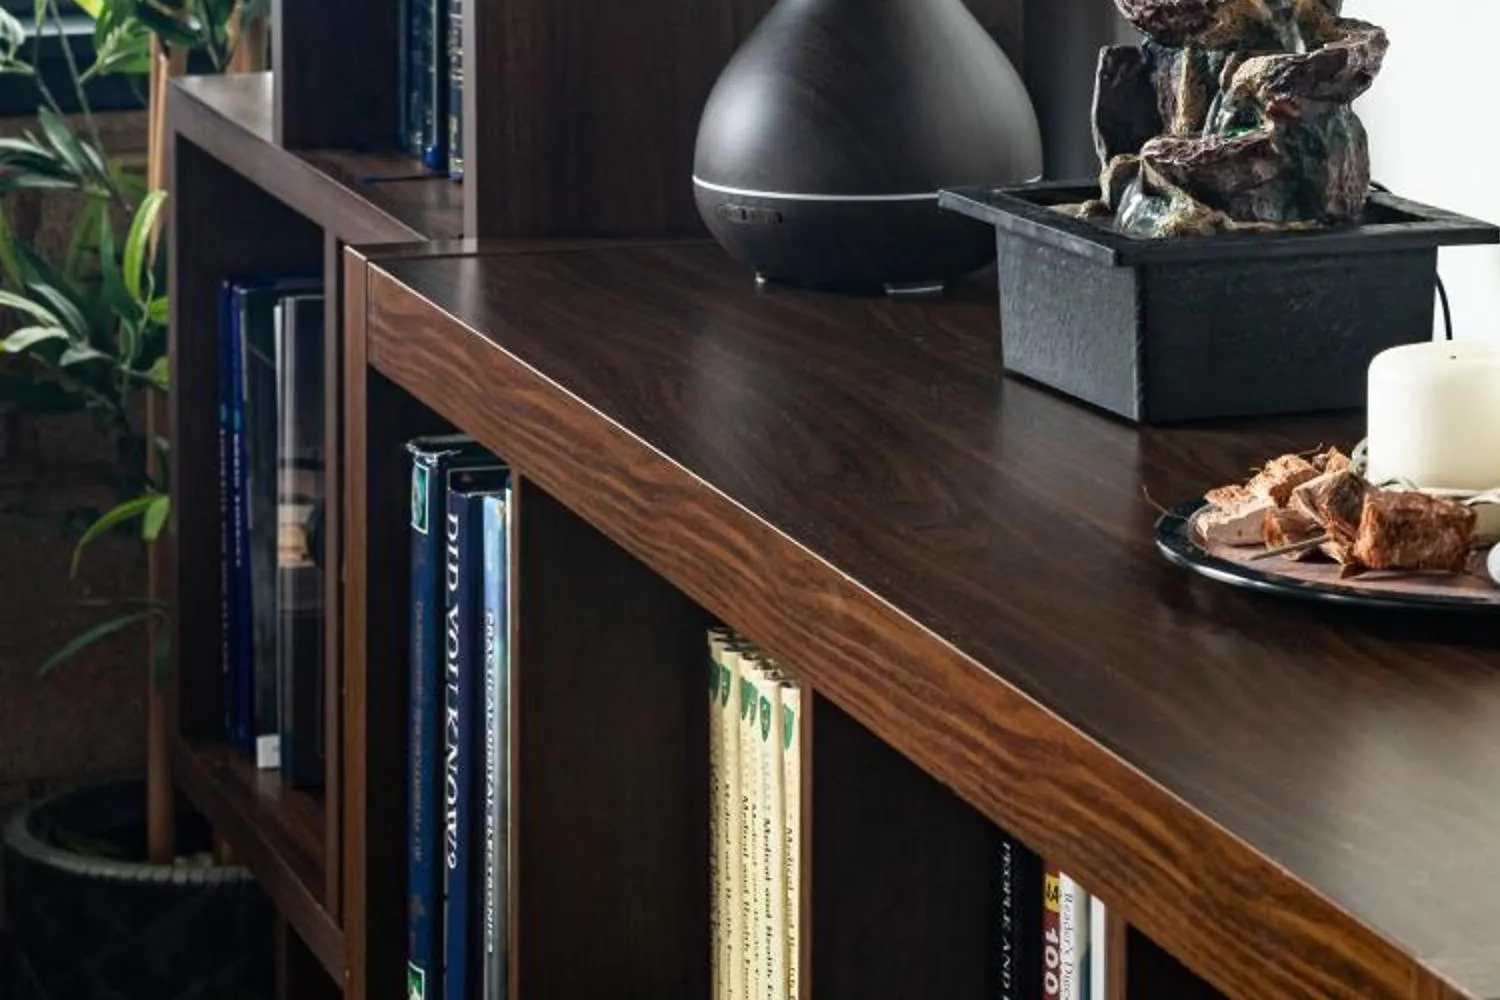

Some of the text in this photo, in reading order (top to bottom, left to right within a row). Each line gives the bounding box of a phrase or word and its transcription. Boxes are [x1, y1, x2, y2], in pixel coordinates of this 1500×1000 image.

[447, 513, 460, 870] DID YOU KNOW?
[763, 816, 772, 881] Medical
[765, 886, 773, 919] and
[765, 924, 774, 978] Health
[1003, 936, 1012, 989] AND
[1045, 927, 1059, 995] 100
